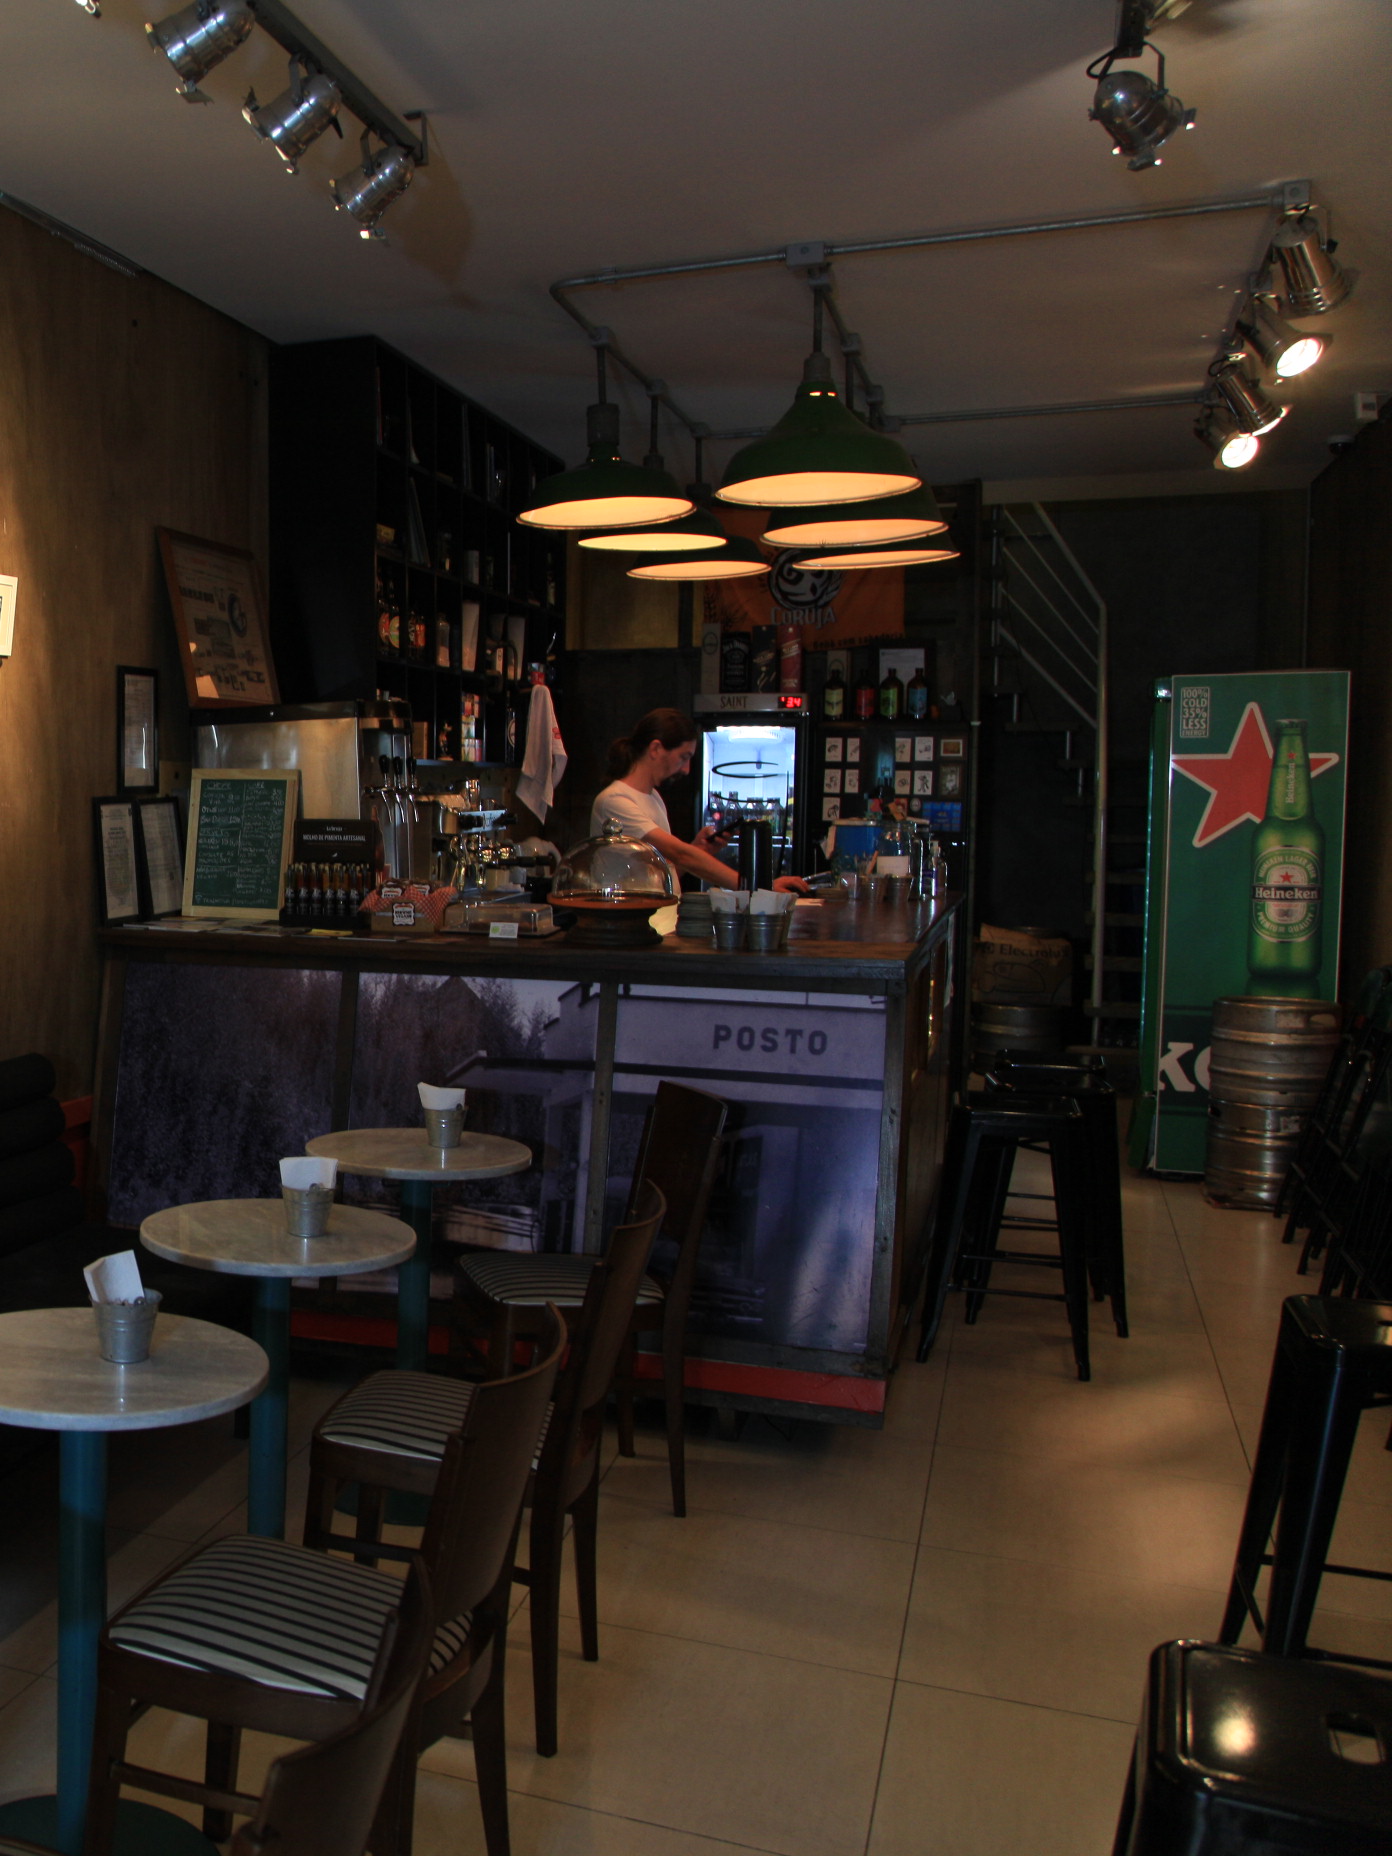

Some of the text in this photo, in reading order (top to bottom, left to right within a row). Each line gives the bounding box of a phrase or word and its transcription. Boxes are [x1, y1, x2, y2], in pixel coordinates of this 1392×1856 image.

[770, 606, 837, 630] CORUJA
[1183, 689, 1208, 698] 100%
[720, 695, 748, 709] SAINT
[1182, 698, 1208, 708] COLD
[1182, 708, 1207, 718] 35%
[1182, 718, 1207, 729] LESS
[1285, 762, 1296, 804] Heineken
[318, 833, 324, 841] DE
[324, 833, 343, 841] PIMENTA
[343, 833, 366, 842] ARTESANAL
[1284, 855, 1308, 867] LAGER
[1255, 887, 1318, 899] Heineken
[1288, 911, 1315, 932] QUALITY
[713, 1024, 828, 1056] POSTO
